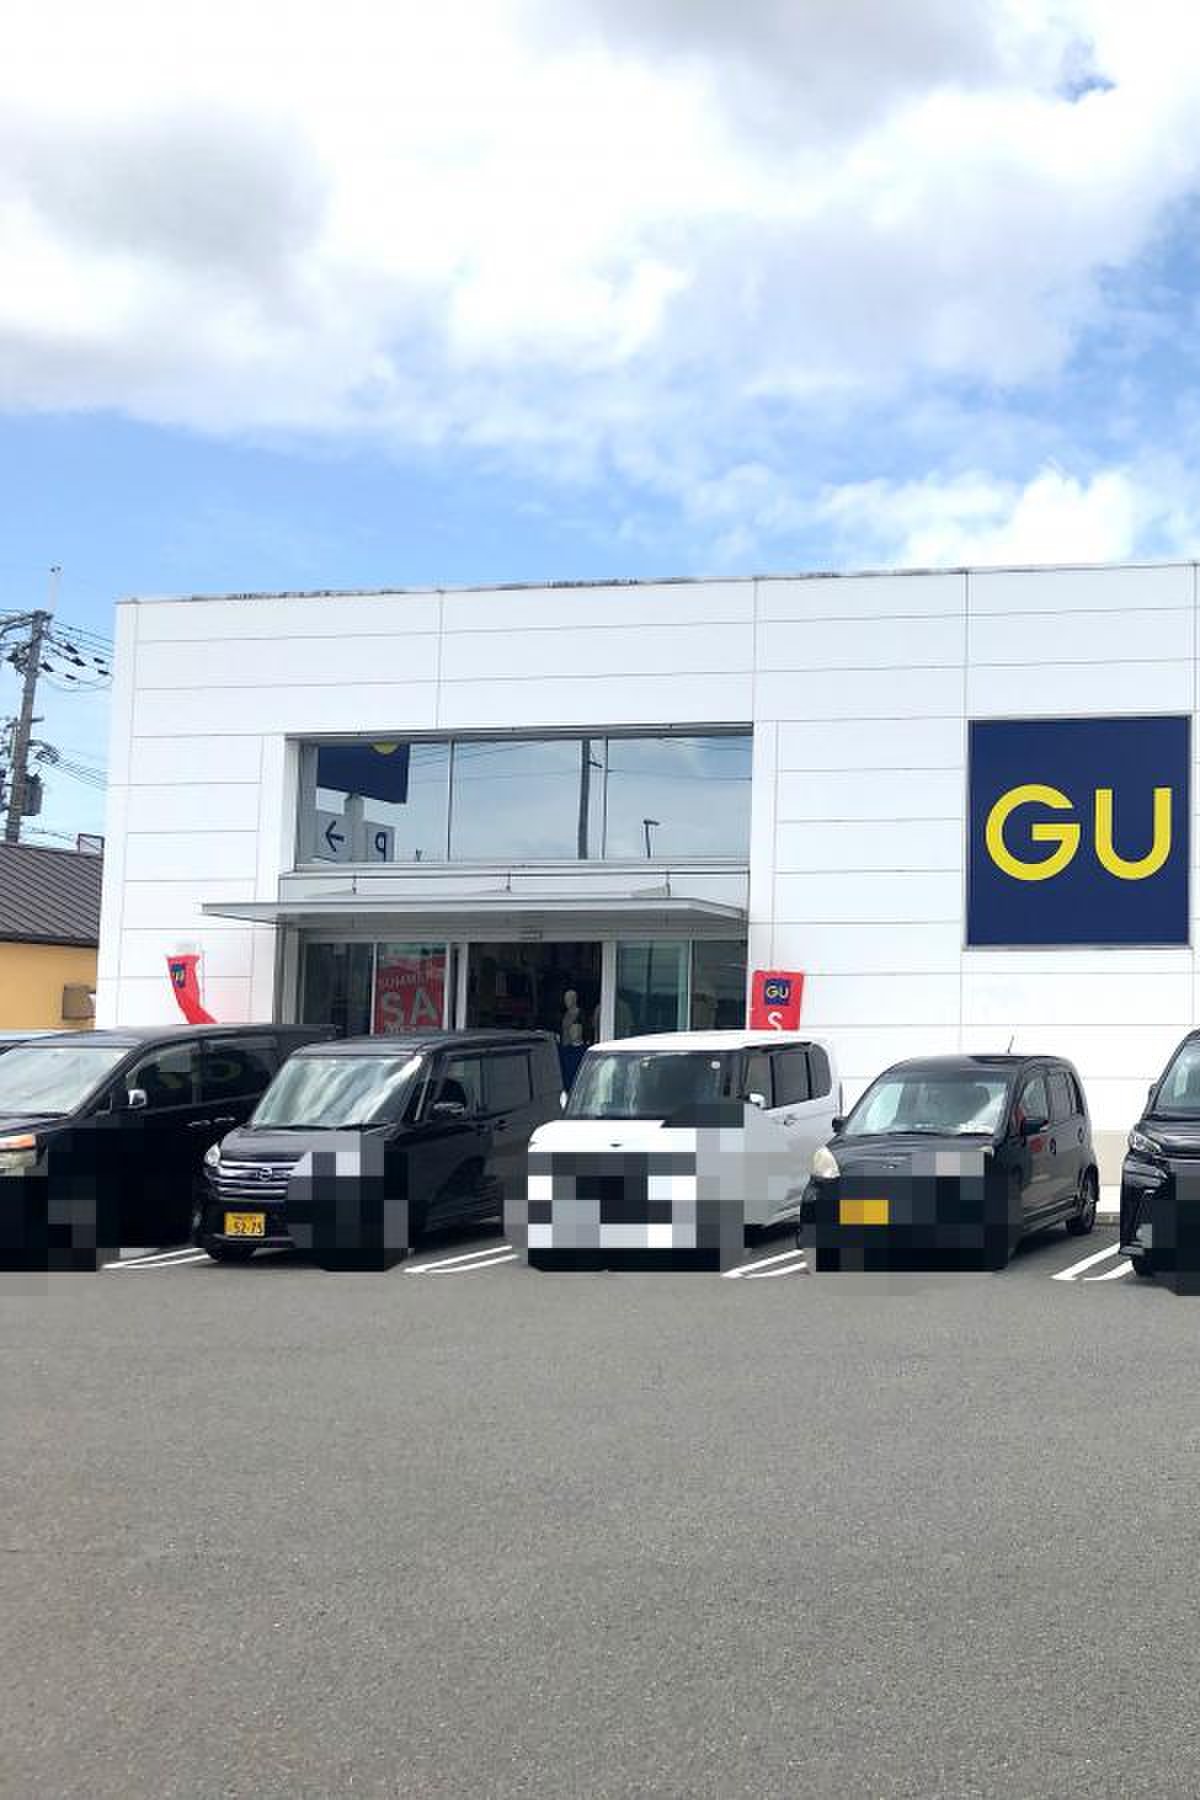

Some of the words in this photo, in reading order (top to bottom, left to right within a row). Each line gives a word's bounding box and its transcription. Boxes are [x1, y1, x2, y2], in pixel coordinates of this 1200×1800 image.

[986, 784, 1172, 880] GU
[383, 990, 438, 1024] SA
[766, 985, 789, 999] GU
